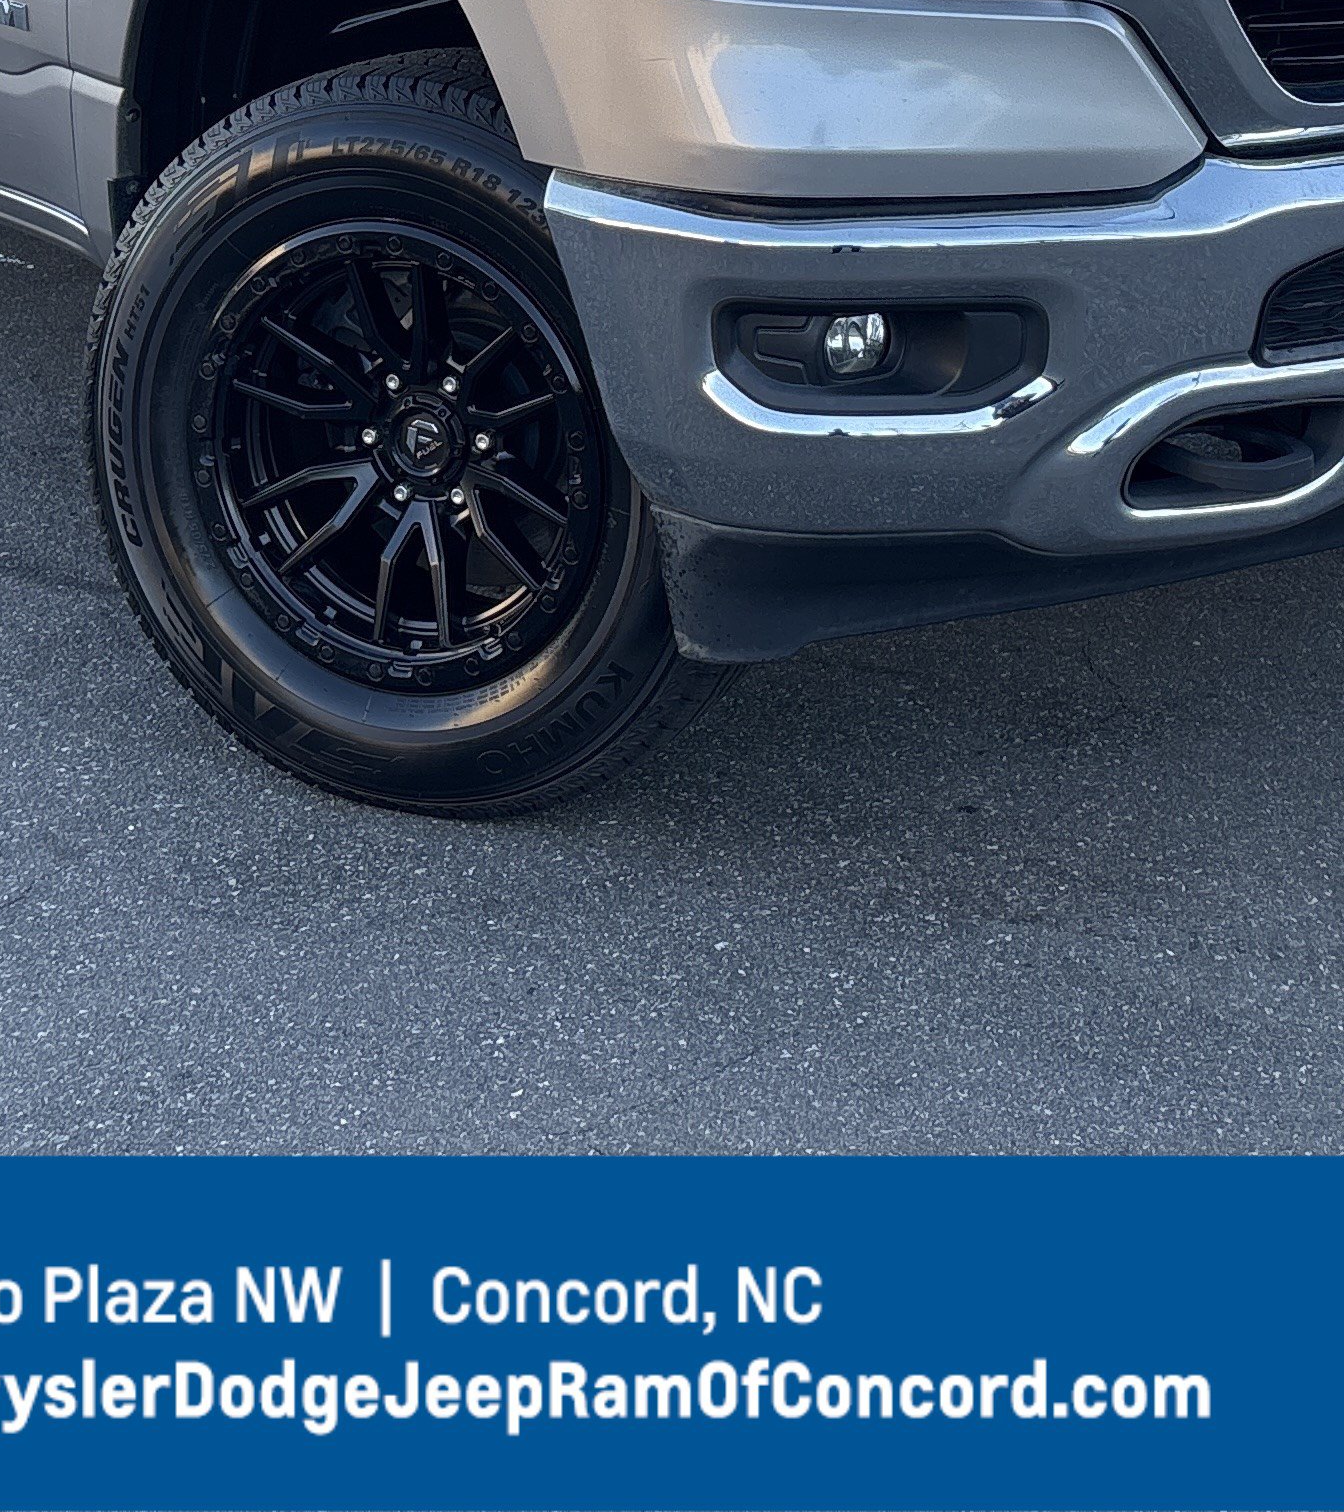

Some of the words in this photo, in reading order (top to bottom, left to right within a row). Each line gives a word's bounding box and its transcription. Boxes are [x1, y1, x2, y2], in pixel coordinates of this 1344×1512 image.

[331, 135, 447, 166] LT275/65
[450, 156, 502, 191] R18
[123, 283, 151, 340] HT51
[108, 337, 144, 548] CRUGEN
[416, 441, 444, 460] FUEL
[476, 660, 635, 775] KUMHO
